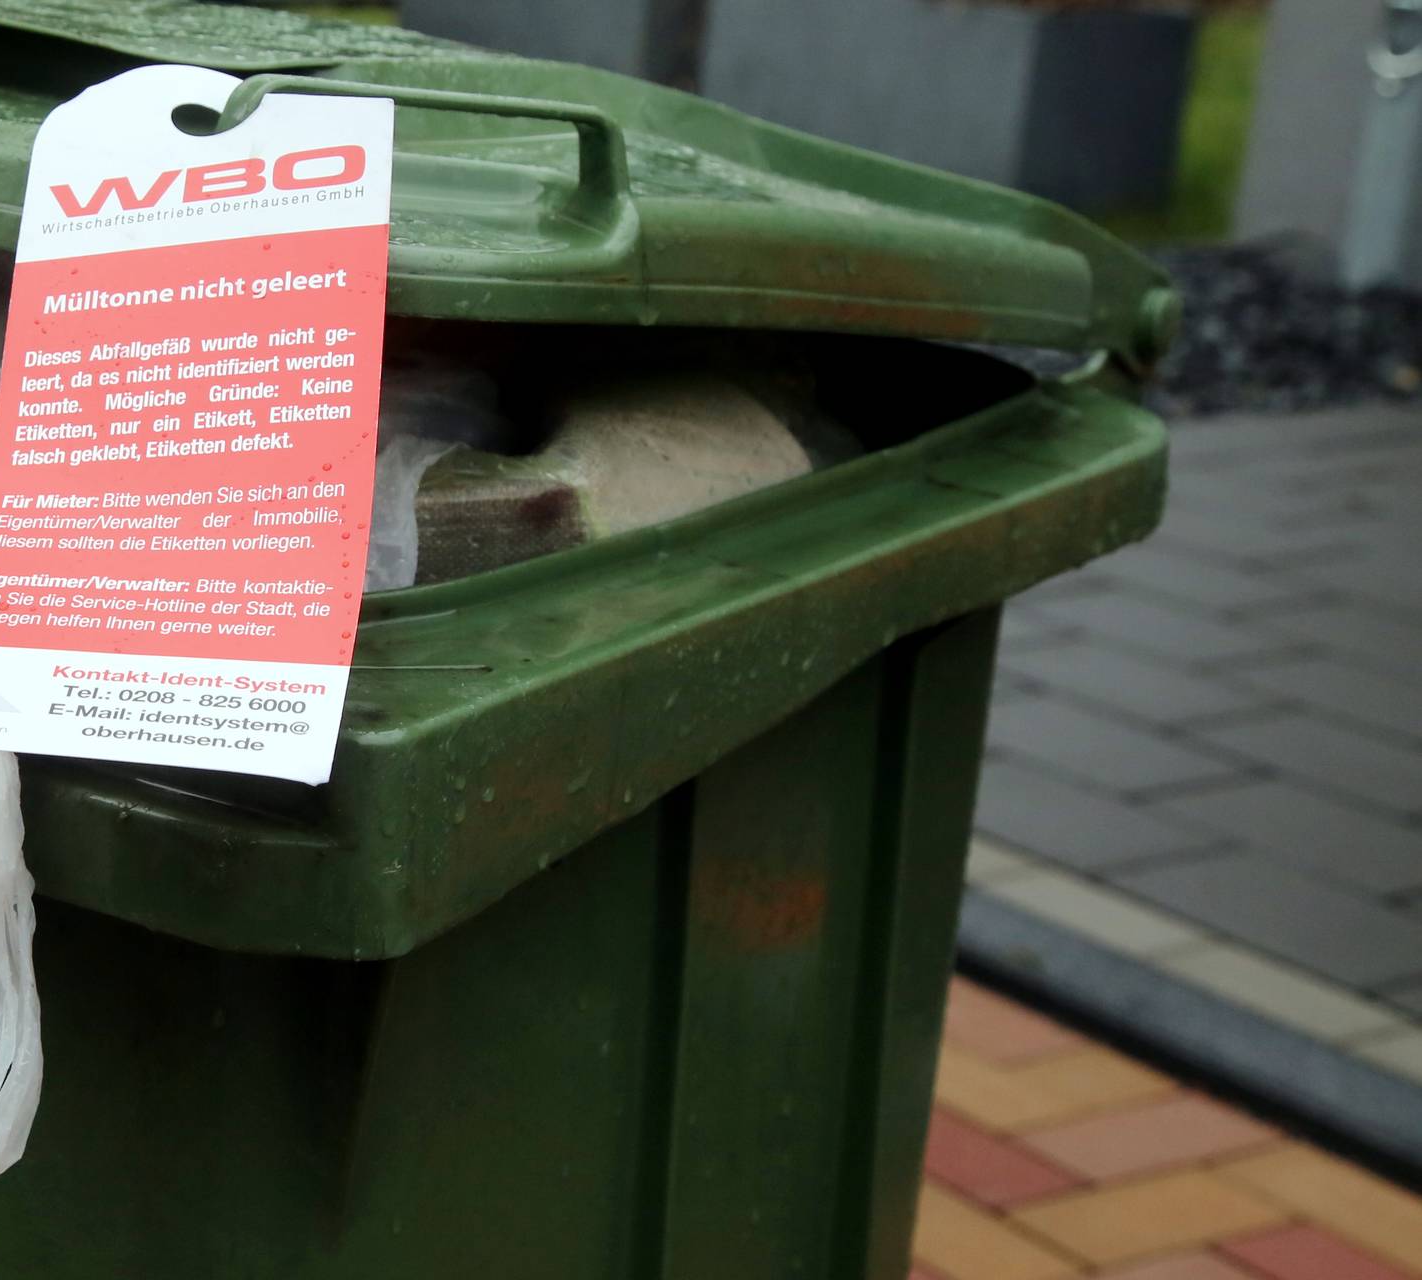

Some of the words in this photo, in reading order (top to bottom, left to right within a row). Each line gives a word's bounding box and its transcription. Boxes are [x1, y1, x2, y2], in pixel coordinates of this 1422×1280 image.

[49, 145, 366, 218] WBO
[42, 204, 204, 235] Wirtschaftsbetriebe
[210, 193, 309, 214] Oberhausen
[317, 186, 365, 201] GmbH
[43, 285, 174, 314] Mülltonne
[180, 277, 244, 301] nicht
[251, 269, 347, 298] geleert
[25, 350, 81, 368] Dieses
[90, 338, 191, 362] Abfallgefäß
[201, 332, 258, 352] wurde
[268, 329, 315, 346] nicht
[325, 327, 356, 346] ge-
[22, 374, 64, 393] leert,
[70, 371, 92, 389] da
[99, 371, 119, 385] es
[126, 364, 171, 384] nicht
[177, 356, 279, 381] identifiziert
[286, 353, 354, 372] werden
[19, 399, 82, 417] konnte.
[105, 390, 186, 413] Mögliche
[209, 382, 279, 402] Gründe:
[301, 377, 353, 395] Keine
[15, 422, 97, 442] Etiketten,
[110, 418, 140, 436] nur
[153, 414, 180, 432] ein
[193, 409, 256, 430] Etikett,
[269, 404, 351, 424] Etiketten
[11, 445, 65, 466] falsch
[70, 442, 141, 466] geklebt,
[146, 437, 226, 458] Etiketten
[231, 432, 294, 452] defekt.
[2, 495, 32, 509] Für
[36, 494, 99, 509] Mieter:
[102, 492, 140, 509] Bitte
[145, 490, 212, 507] wenden
[216, 487, 243, 504] Sie
[247, 484, 282, 502] sich
[287, 486, 308, 500] an
[312, 482, 345, 499] den
[202, 512, 231, 528] der
[253, 508, 342, 527] Immobilie,
[58, 535, 114, 550] sollten
[119, 535, 146, 551] die
[150, 535, 226, 551] Etiketten
[232, 535, 315, 553] vorliegen.
[196, 579, 236, 593] Bitte
[243, 579, 333, 594] kontaktie-
[7, 591, 34, 605] Sie
[39, 593, 65, 607] die
[71, 594, 205, 614] Service-Hotline
[211, 601, 242, 615] der
[246, 602, 297, 617] Stadt,
[303, 602, 330, 617] die
[46, 612, 102, 628] helfen
[106, 616, 155, 631] Ihnen
[160, 620, 212, 636] gerne
[217, 621, 276, 637] weiter.
[52, 665, 326, 696] Kontakt-Ident-System
[63, 685, 111, 700] Tel.:
[118, 687, 174, 705] 0208
[198, 693, 242, 709] 825
[248, 697, 306, 714] 6000
[48, 703, 133, 721] E-Mail:
[139, 708, 310, 736] identsystem@
[81, 724, 265, 751] oberhausen.de
